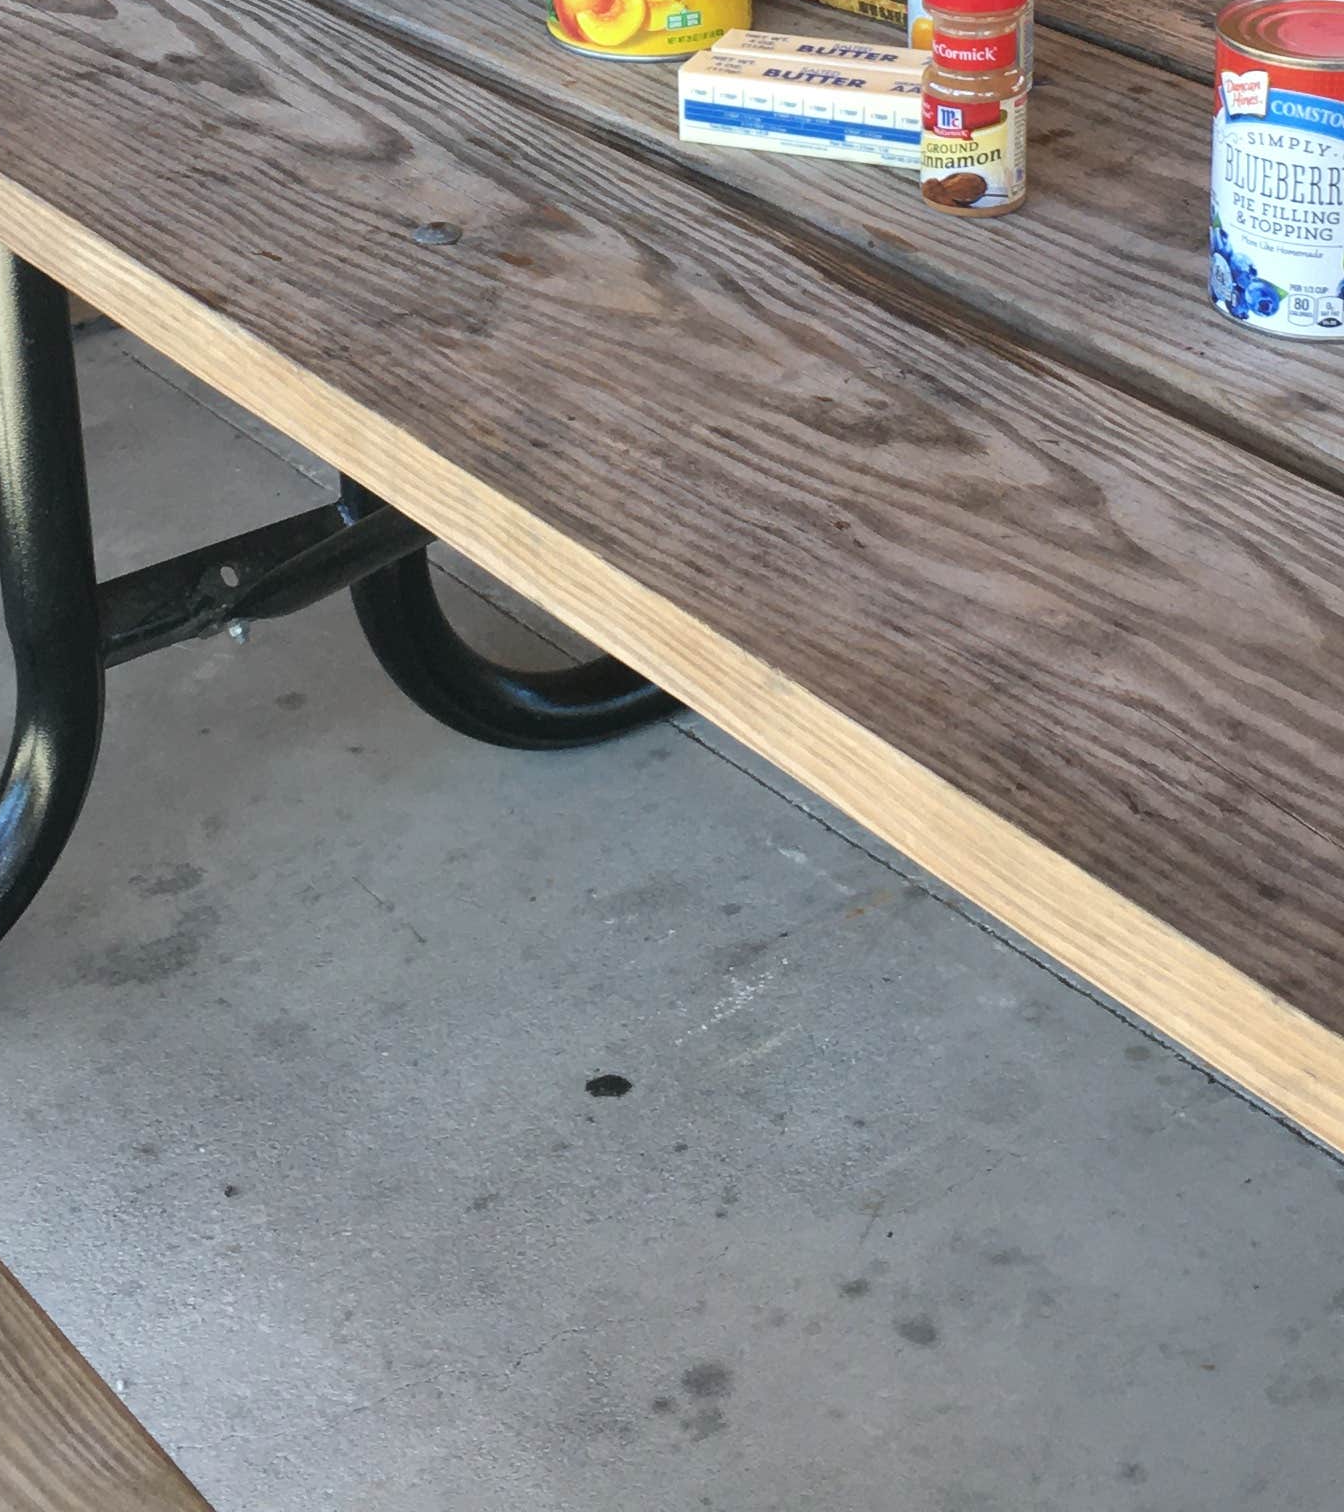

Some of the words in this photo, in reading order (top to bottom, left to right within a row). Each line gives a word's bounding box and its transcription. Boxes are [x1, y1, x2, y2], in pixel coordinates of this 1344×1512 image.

[796, 44, 899, 63] BUTTER
[762, 68, 867, 89] BUTTER
[926, 141, 980, 154] GROUND
[1247, 131, 1332, 157] SIMPLY
[922, 148, 1002, 170] innamon
[1233, 192, 1255, 212] PIE
[1262, 203, 1341, 225] FILLING
[1236, 211, 1247, 225] &
[1251, 215, 1334, 242] TOPPING
[1294, 298, 1310, 311] 80
